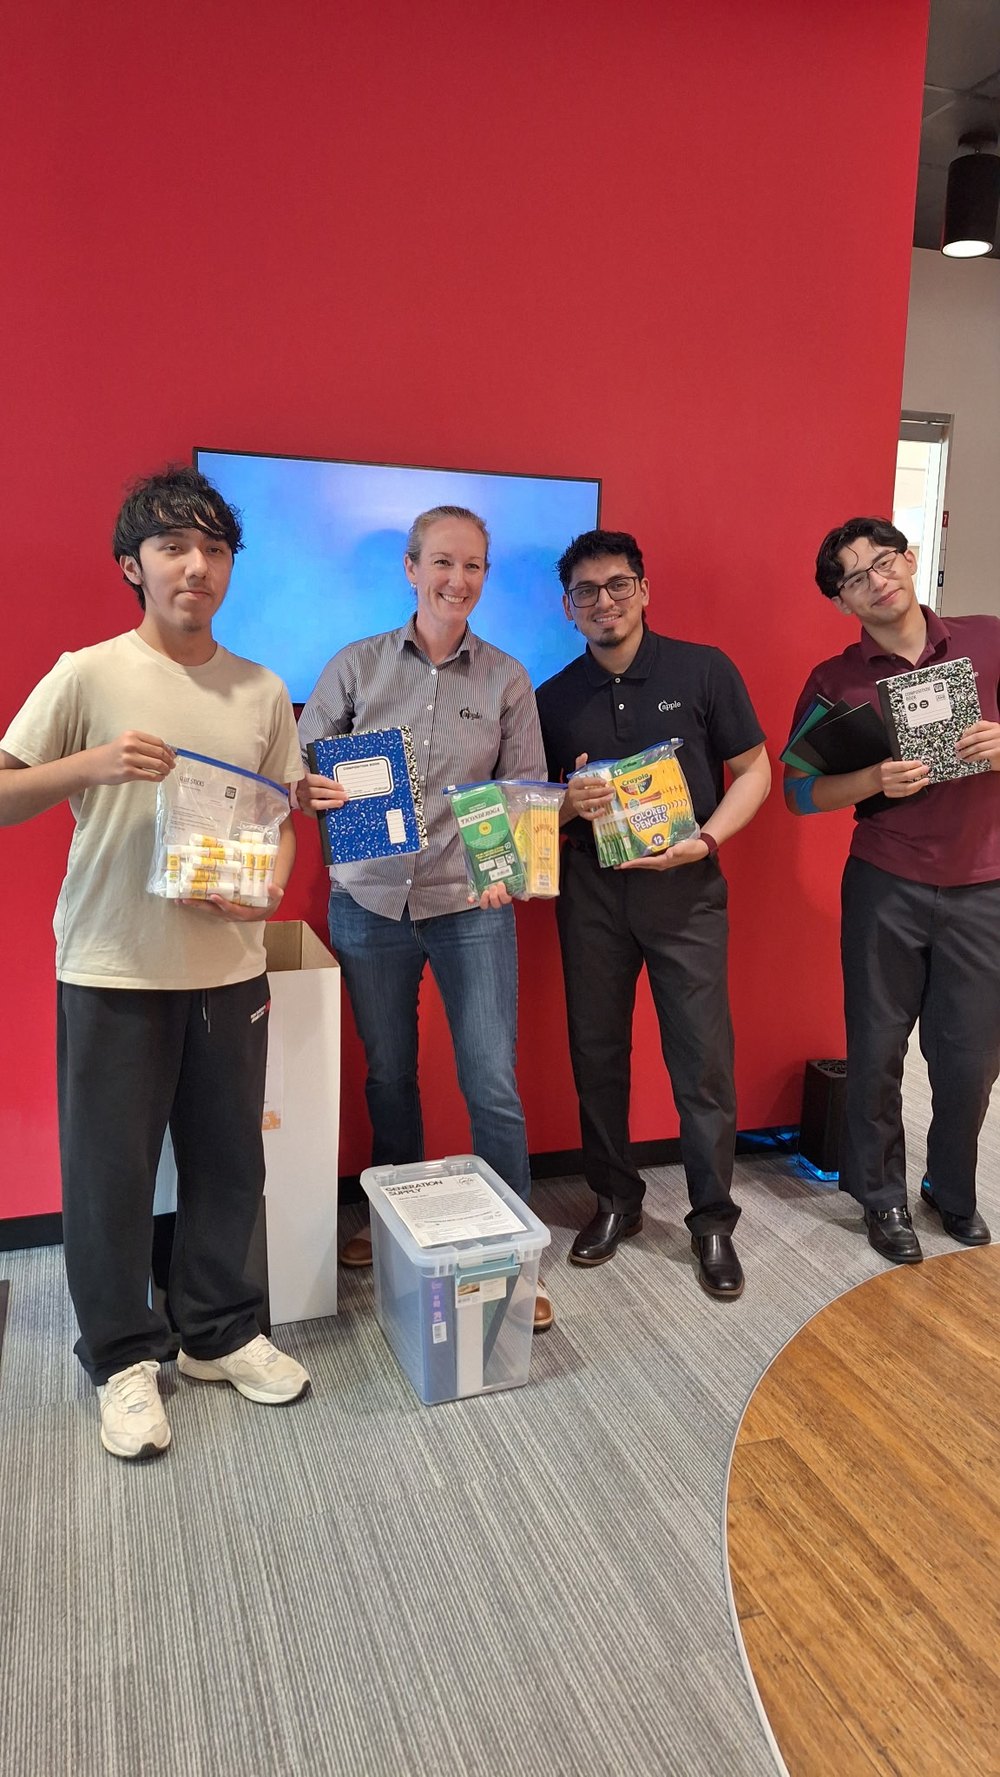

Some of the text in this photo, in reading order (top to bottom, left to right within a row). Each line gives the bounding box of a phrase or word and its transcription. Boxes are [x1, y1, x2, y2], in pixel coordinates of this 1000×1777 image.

[622, 773, 649, 786] Crayola
[630, 805, 667, 824] COLORED
[634, 813, 669, 832] PENCILS
[653, 835, 662, 845] 12
[385, 1180, 443, 1192] GENERATION
[388, 1188, 421, 1196] SUPPLY
